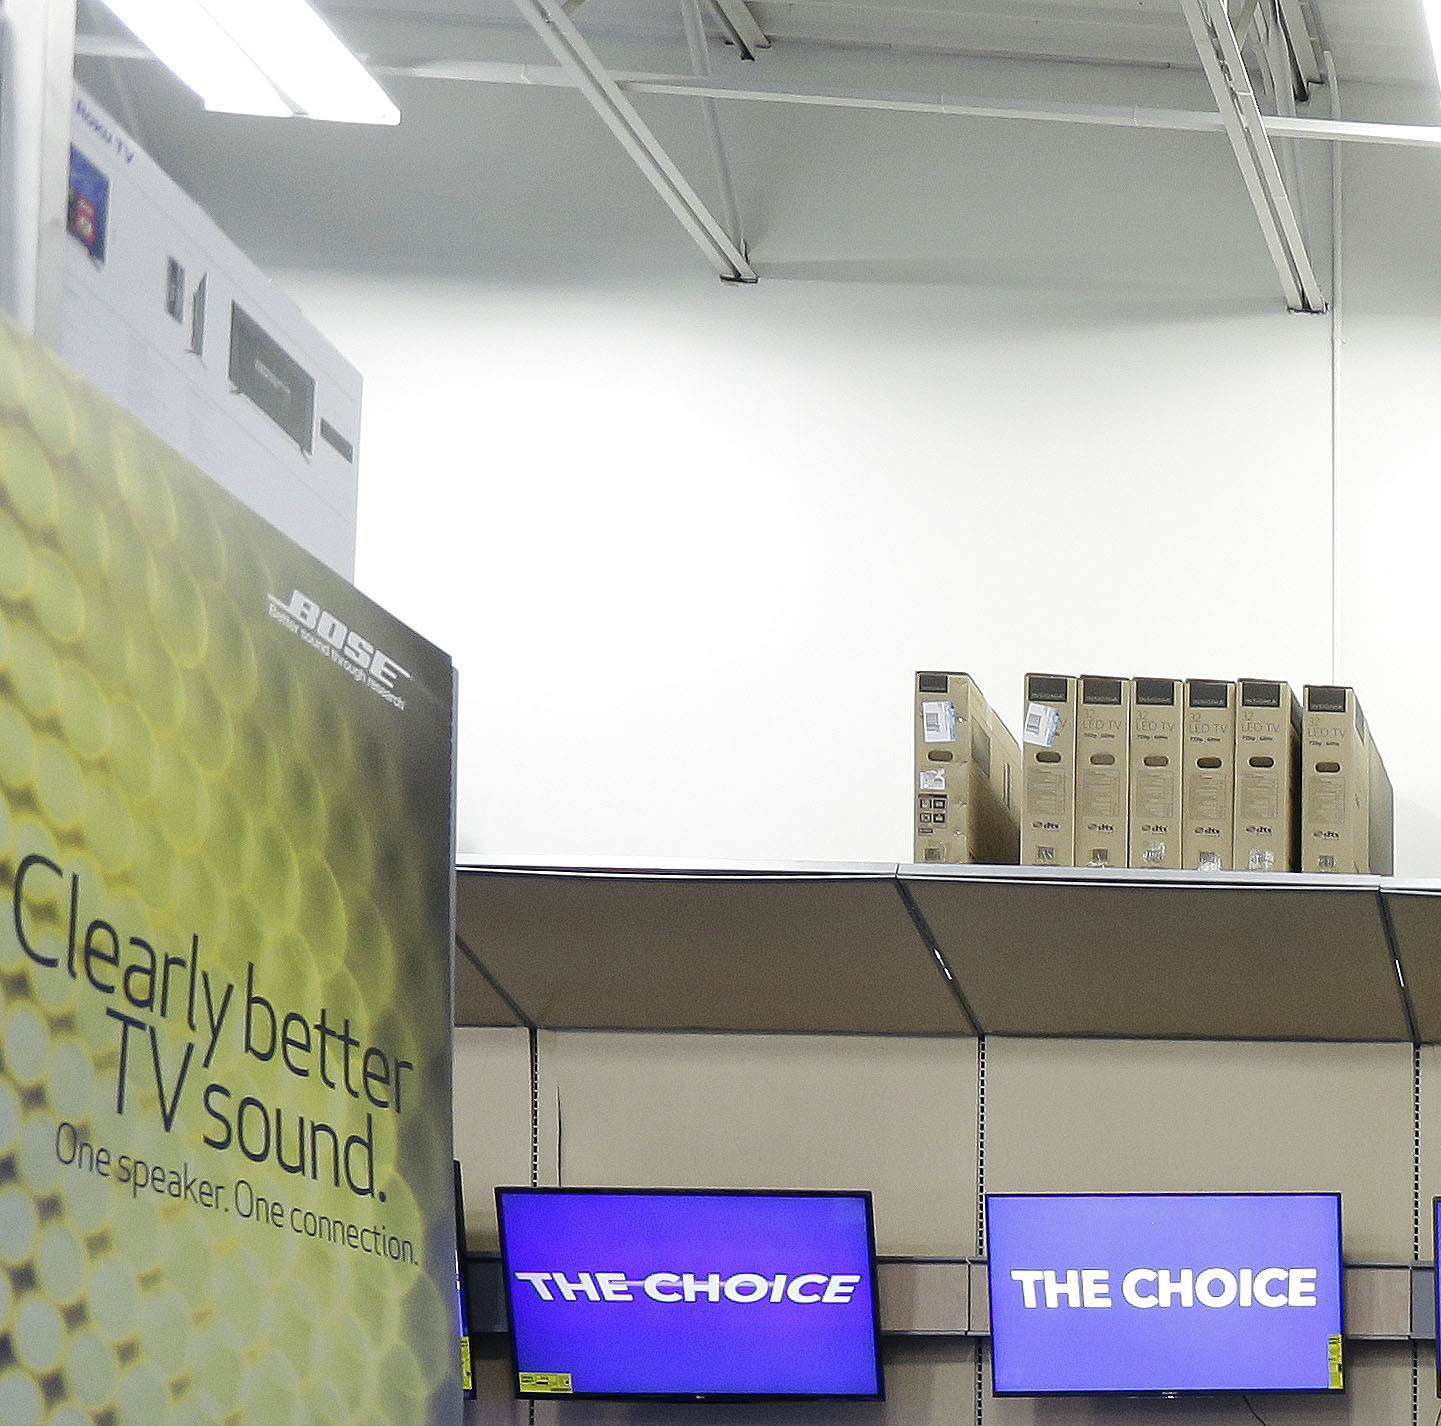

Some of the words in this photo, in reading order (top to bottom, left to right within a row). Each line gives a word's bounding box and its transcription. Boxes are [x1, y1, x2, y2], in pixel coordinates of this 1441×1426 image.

[267, 589, 413, 689] BOSE
[1108, 720, 1122, 730] TV
[1135, 721, 1157, 732] LED
[1160, 722, 1175, 733] TV
[1188, 723, 1210, 734] LED
[1213, 724, 1228, 734] TV
[1241, 721, 1263, 732] LED
[1266, 723, 1280, 732] TV
[1308, 727, 1329, 738] LED
[1332, 728, 1346, 738] TV
[13, 853, 233, 1068] Clearly
[245, 962, 413, 1114] better
[106, 1007, 194, 1133] TV
[203, 1083, 387, 1203] sound.
[55, 1122, 111, 1178] One
[118, 1153, 229, 1214] speaker.
[235, 1180, 285, 1228] One
[290, 1203, 419, 1266] connection.
[515, 1271, 633, 1303] THE
[642, 1272, 861, 1304] CHOICE
[1010, 1269, 1112, 1309] THE
[1122, 1268, 1317, 1309] CHOICE
